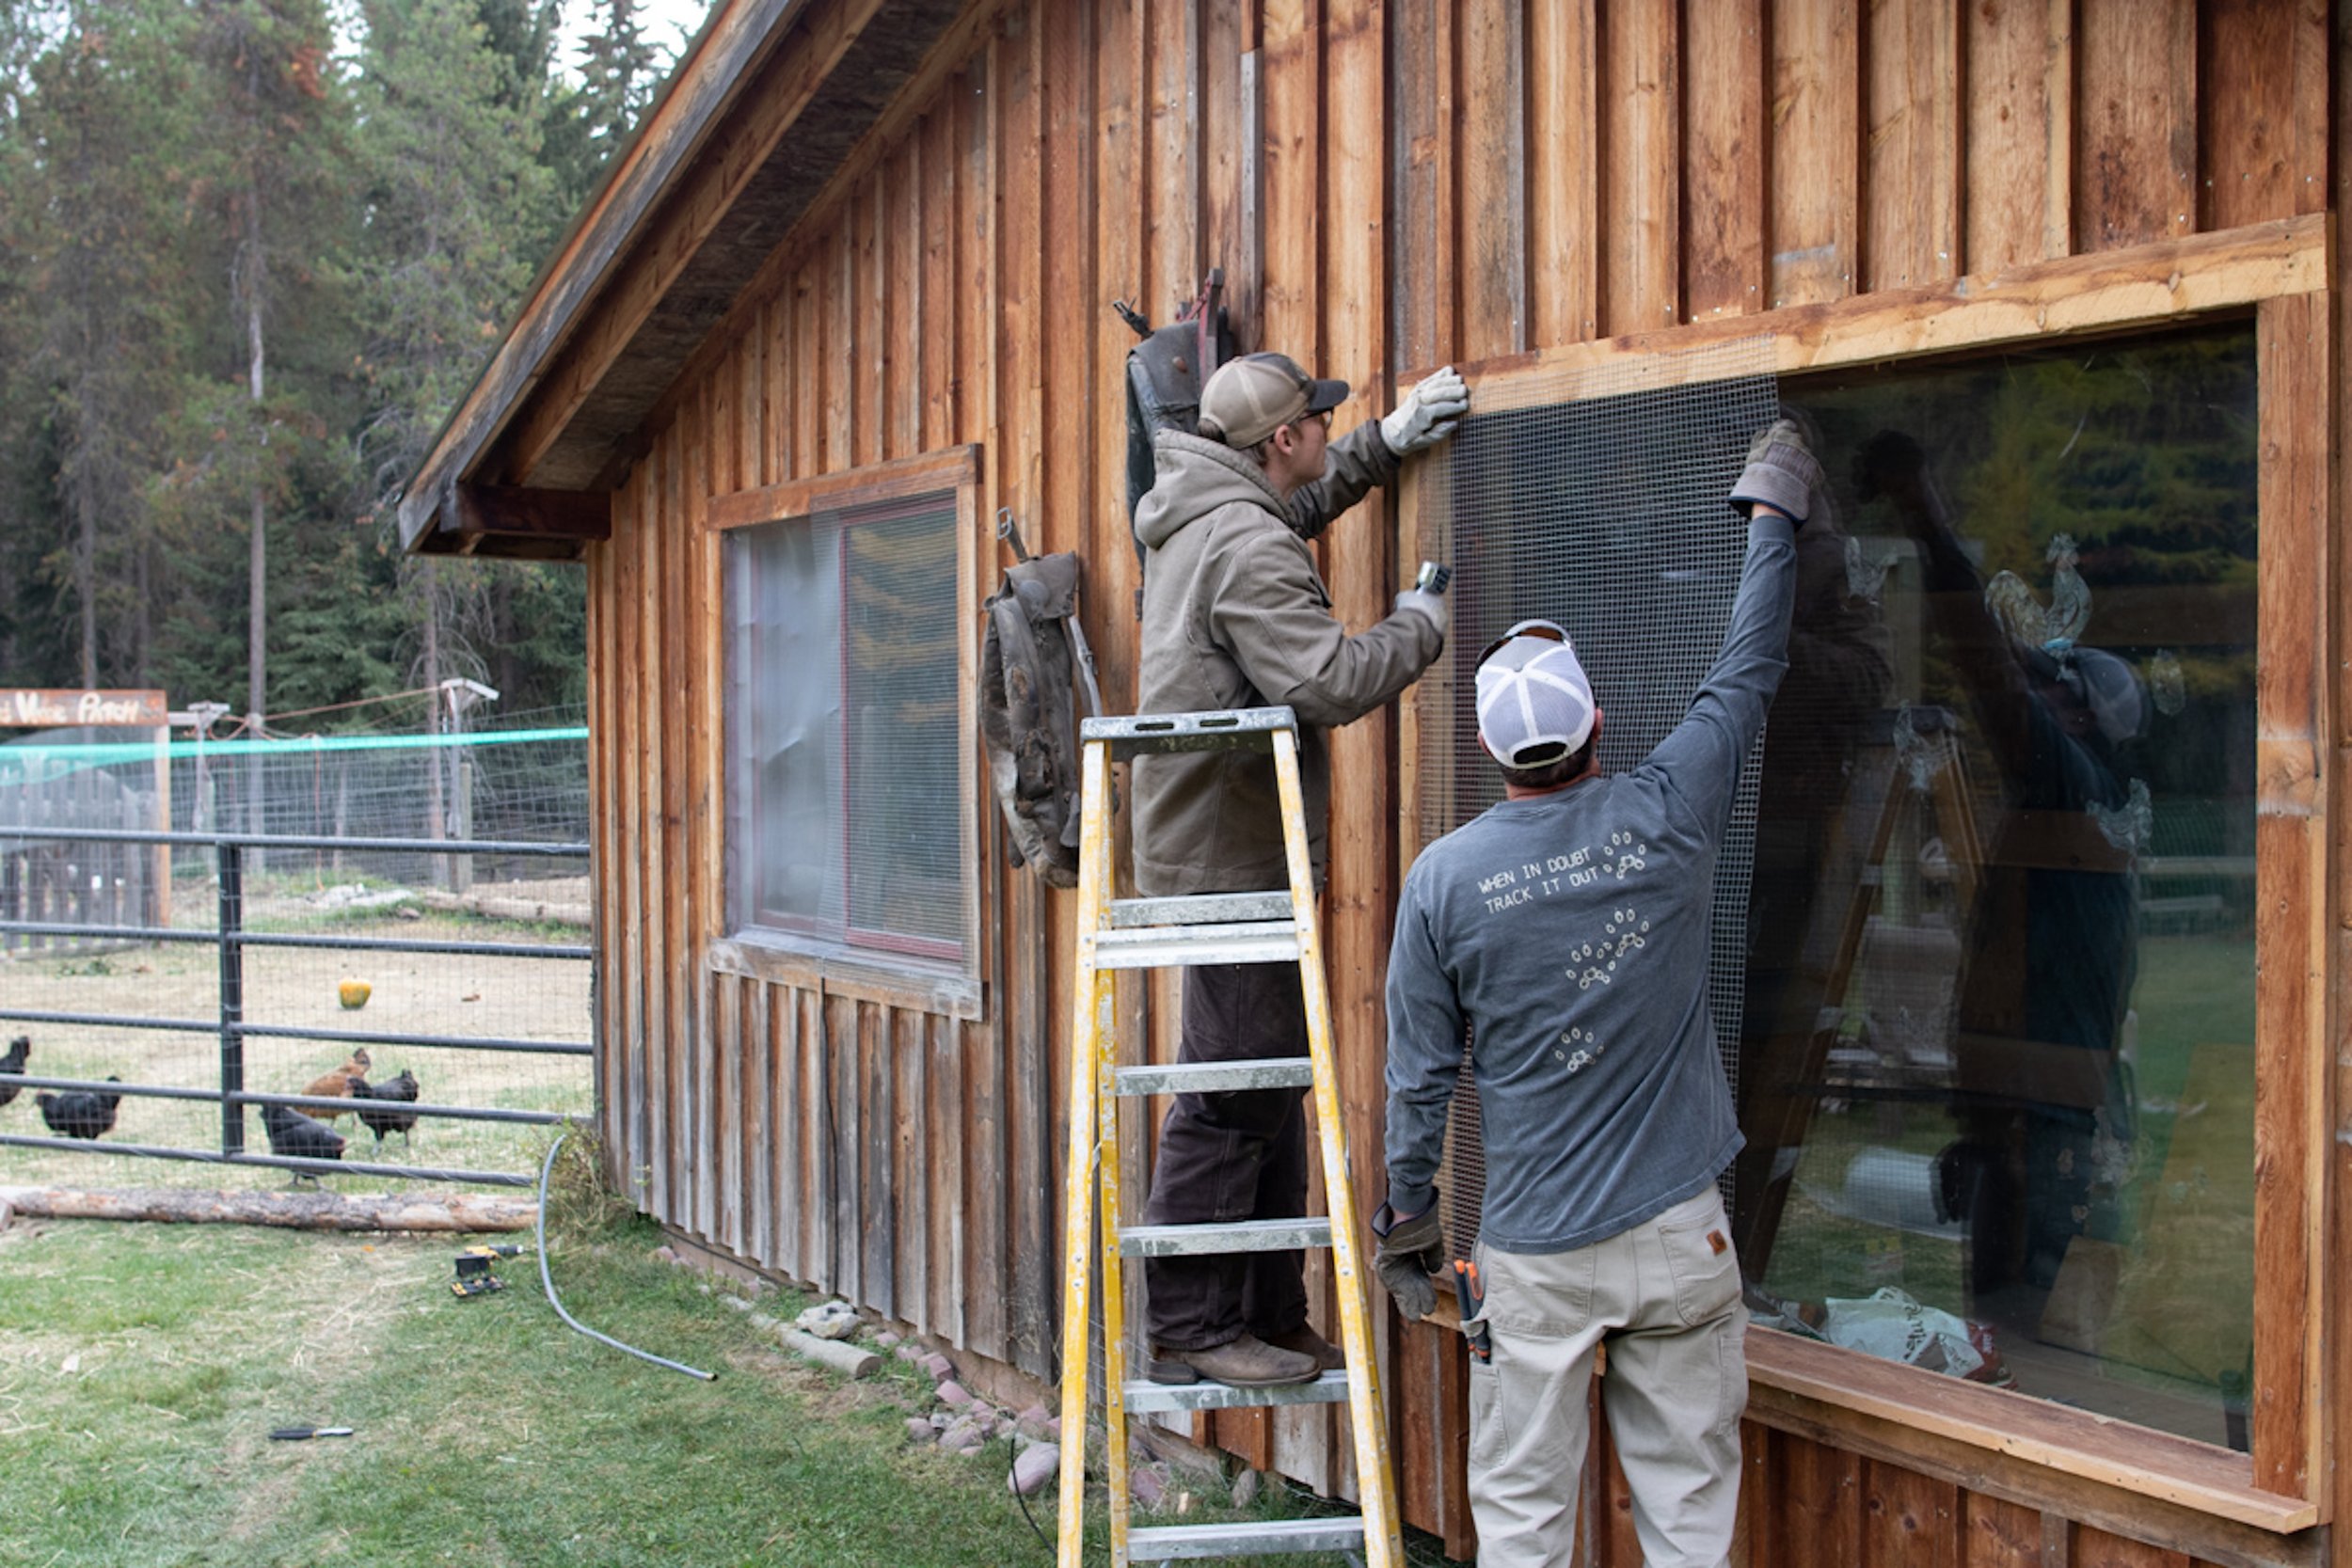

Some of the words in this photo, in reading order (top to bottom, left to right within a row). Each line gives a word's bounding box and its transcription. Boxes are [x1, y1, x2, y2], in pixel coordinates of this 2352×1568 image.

[1477, 870, 1516, 895] WHEN
[1522, 863, 1542, 879] IN
[1547, 847, 1590, 873] DOUBT
[1486, 886, 1534, 914] TRACK
[1542, 877, 1560, 895] IT
[1569, 865, 1598, 887] OUT
